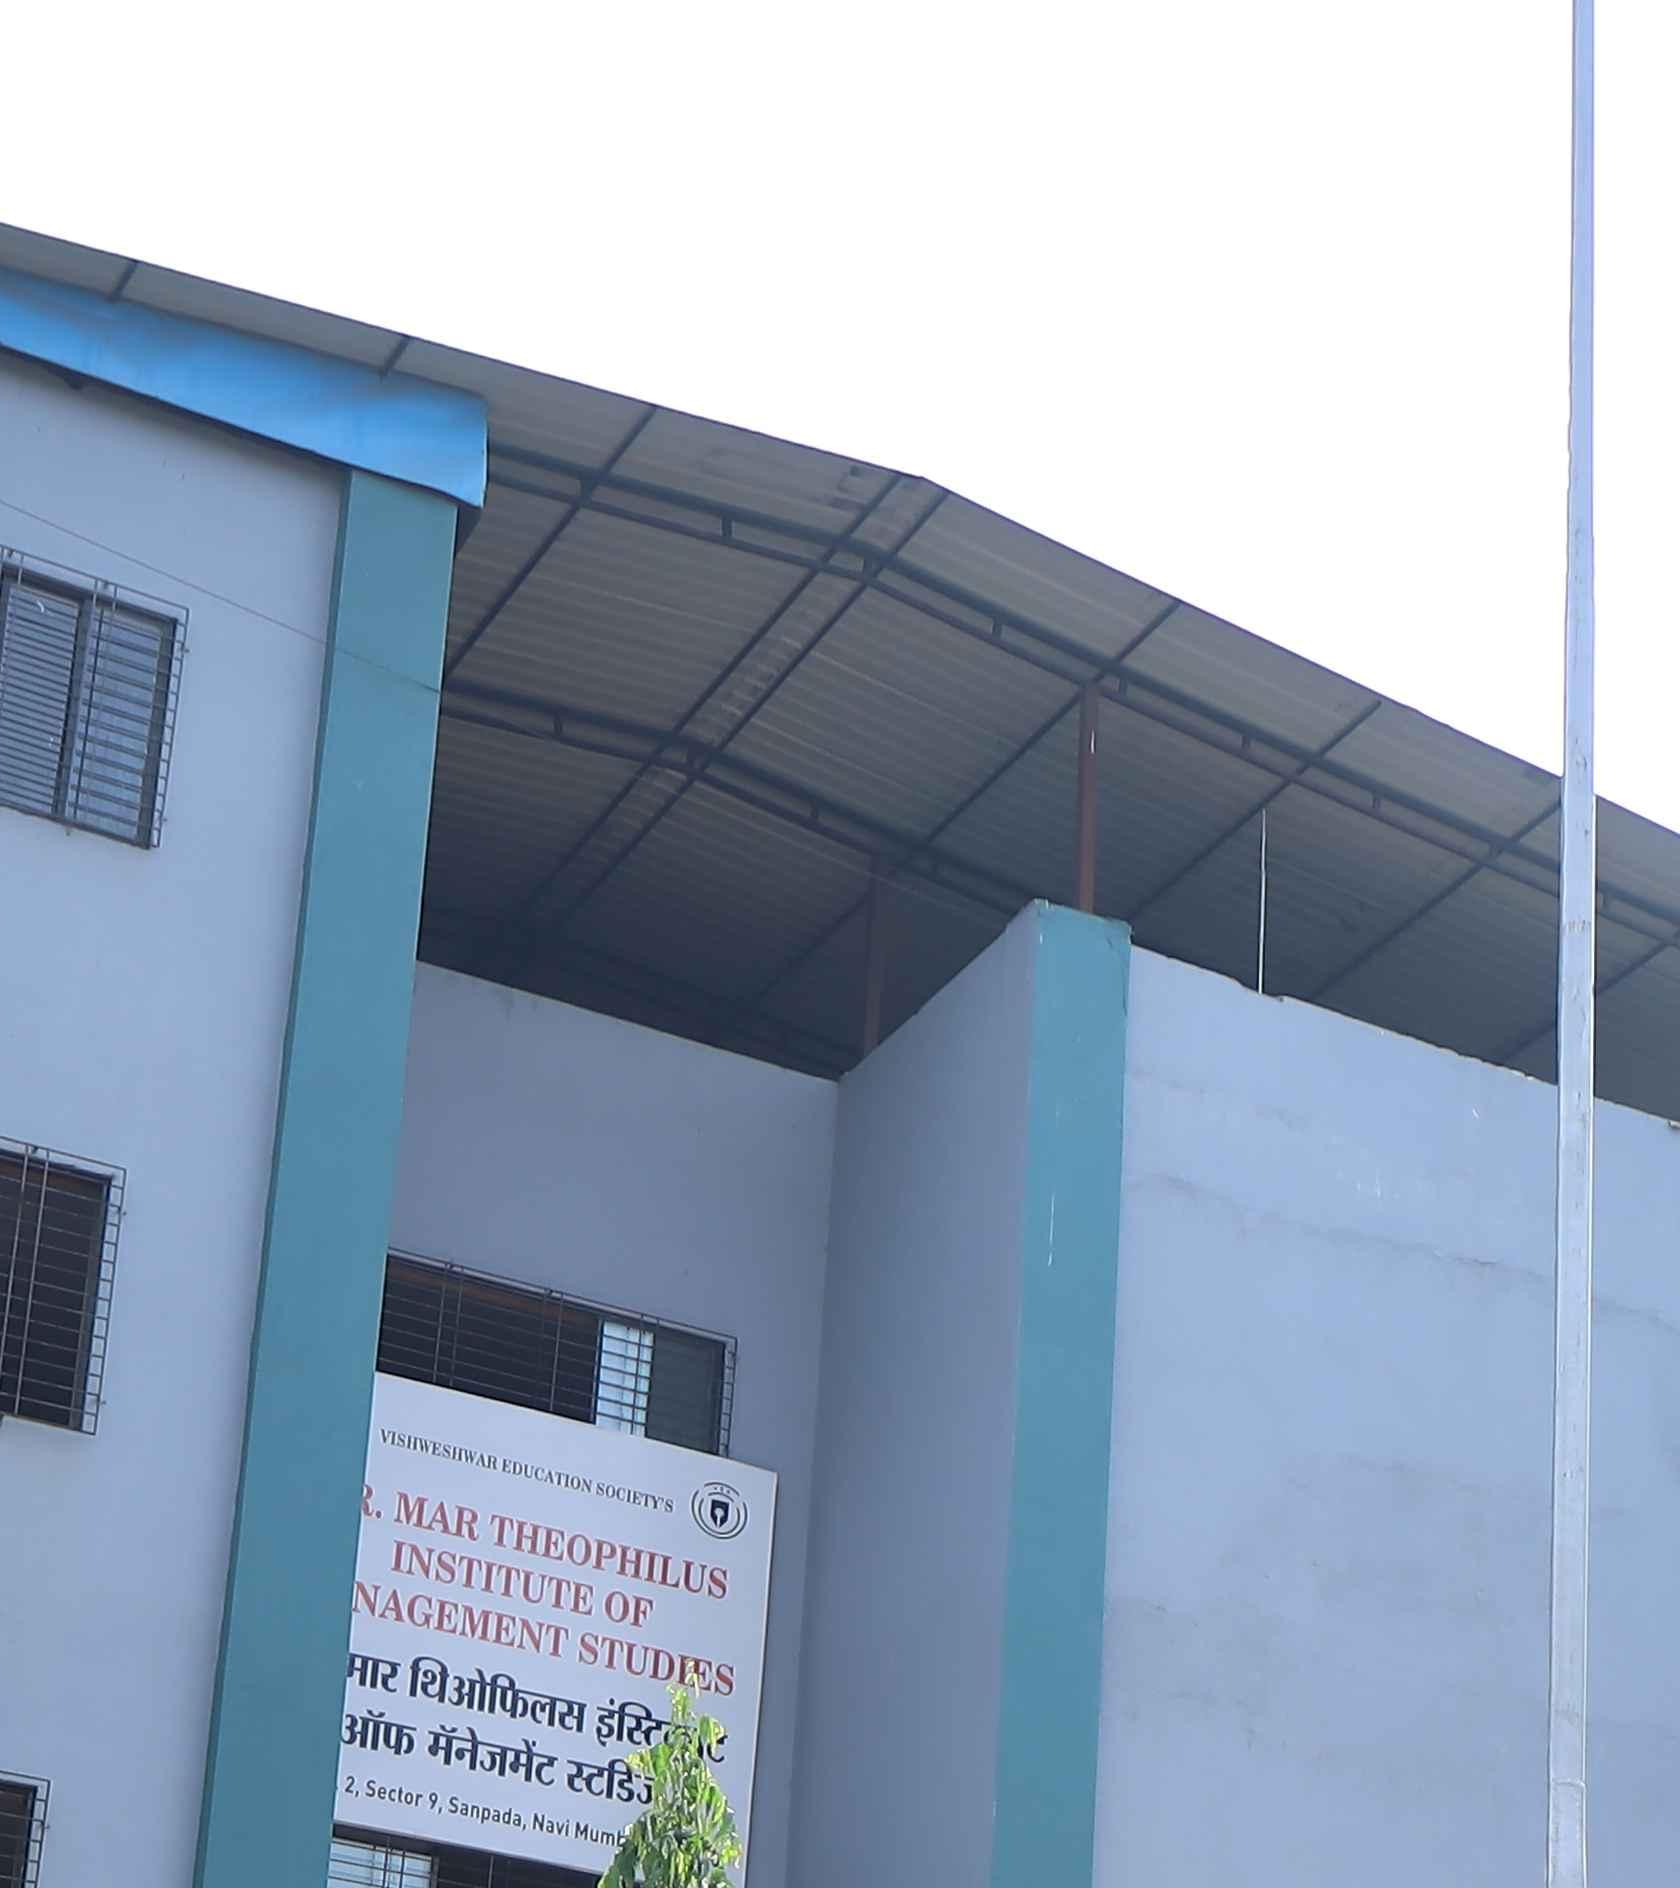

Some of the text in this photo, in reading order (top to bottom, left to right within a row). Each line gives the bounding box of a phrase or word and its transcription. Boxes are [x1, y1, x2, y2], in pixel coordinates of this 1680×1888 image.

[380, 1428, 497, 1470] VISHWESHWAR
[502, 1458, 593, 1494] EDUCATION
[393, 1491, 480, 1542] MAR
[490, 1514, 729, 1600] THEOPHILUS
[390, 1540, 654, 1628] INSTITUTE OF
[409, 1656, 587, 1733] थिओफिलस
[578, 1632, 735, 1697] STUDIES
[340, 1708, 417, 1756] ऑफ
[345, 1776, 360, 1798] 2,
[365, 1779, 423, 1807] Sector
[428, 1792, 443, 1815] 9,
[448, 1796, 527, 1831] Sanpada,
[532, 1812, 570, 1837] Navi
